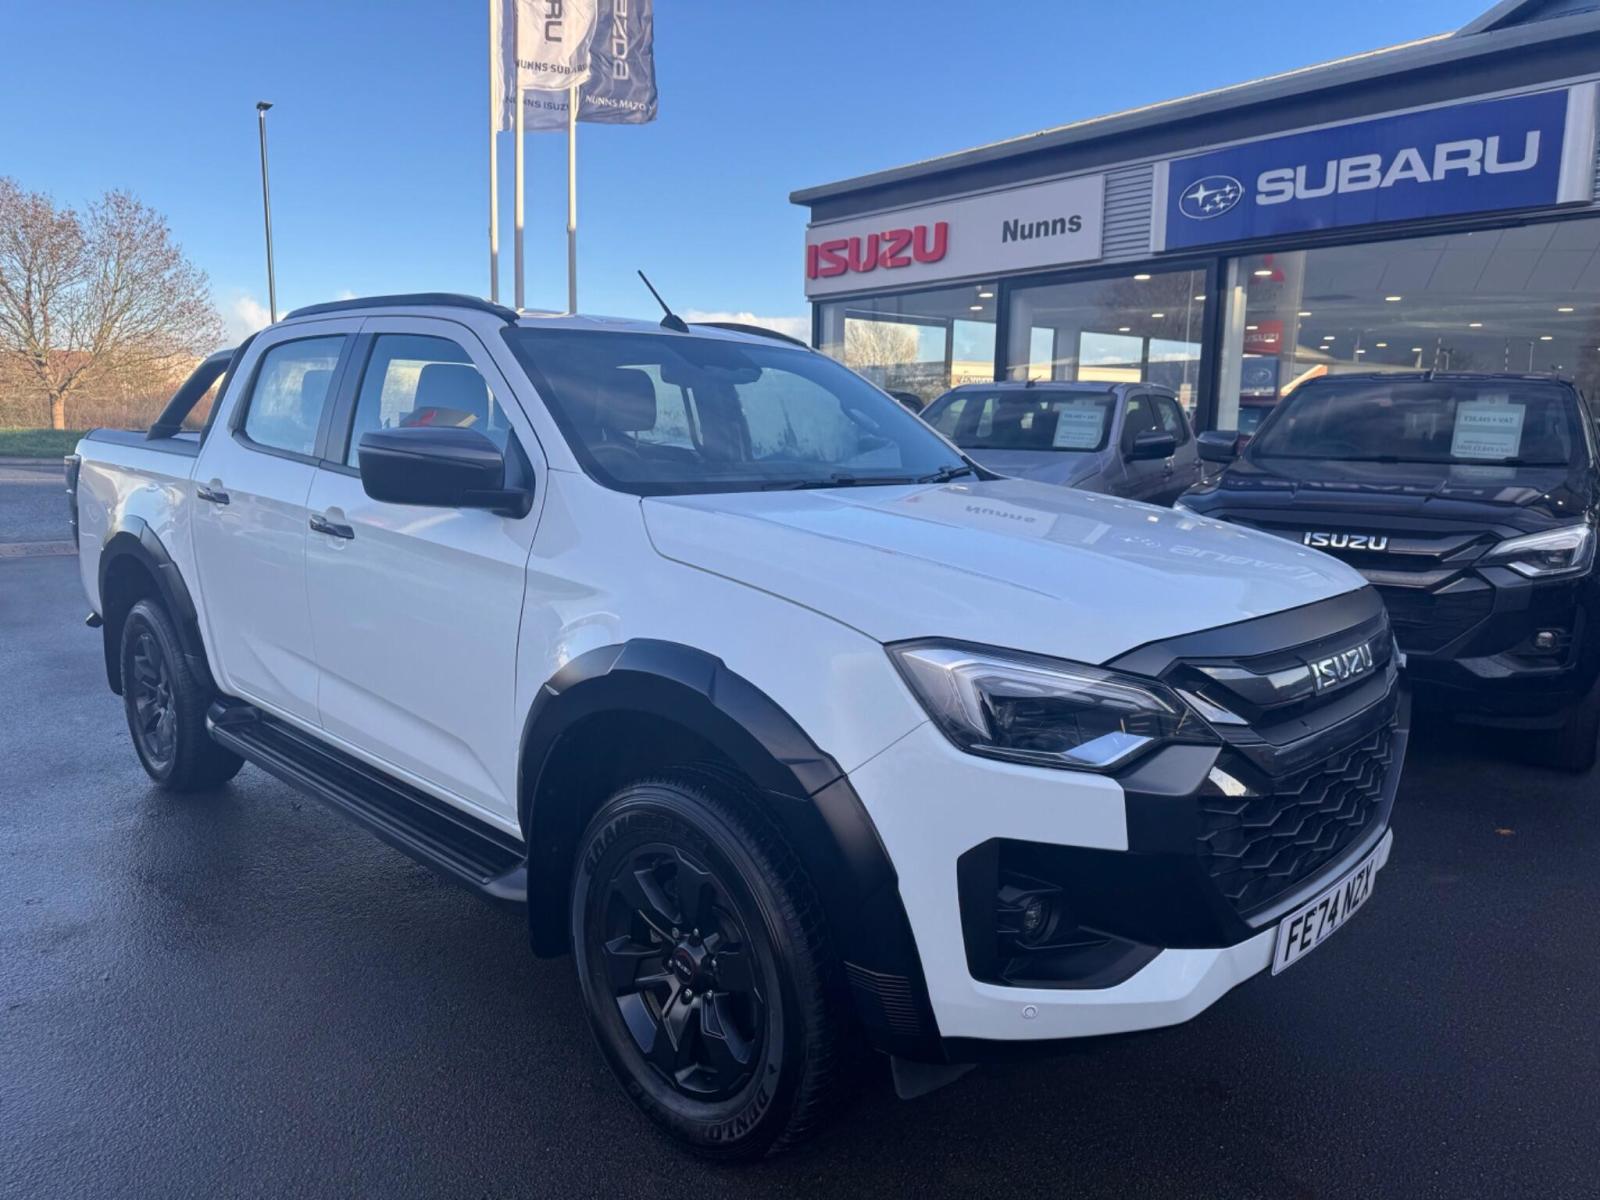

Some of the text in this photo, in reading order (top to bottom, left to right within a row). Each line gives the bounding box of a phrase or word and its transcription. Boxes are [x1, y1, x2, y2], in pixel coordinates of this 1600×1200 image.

[543, 100, 569, 112] ISUZ
[585, 95, 618, 108] NUNNS
[1256, 130, 1541, 206] SUBARU
[1002, 214, 1083, 243] Nunns
[807, 221, 949, 280] ISUZU
[1303, 531, 1388, 551] ISUZU
[1310, 643, 1373, 690] ISUZU
[1284, 859, 1375, 962] FE74 NZX
